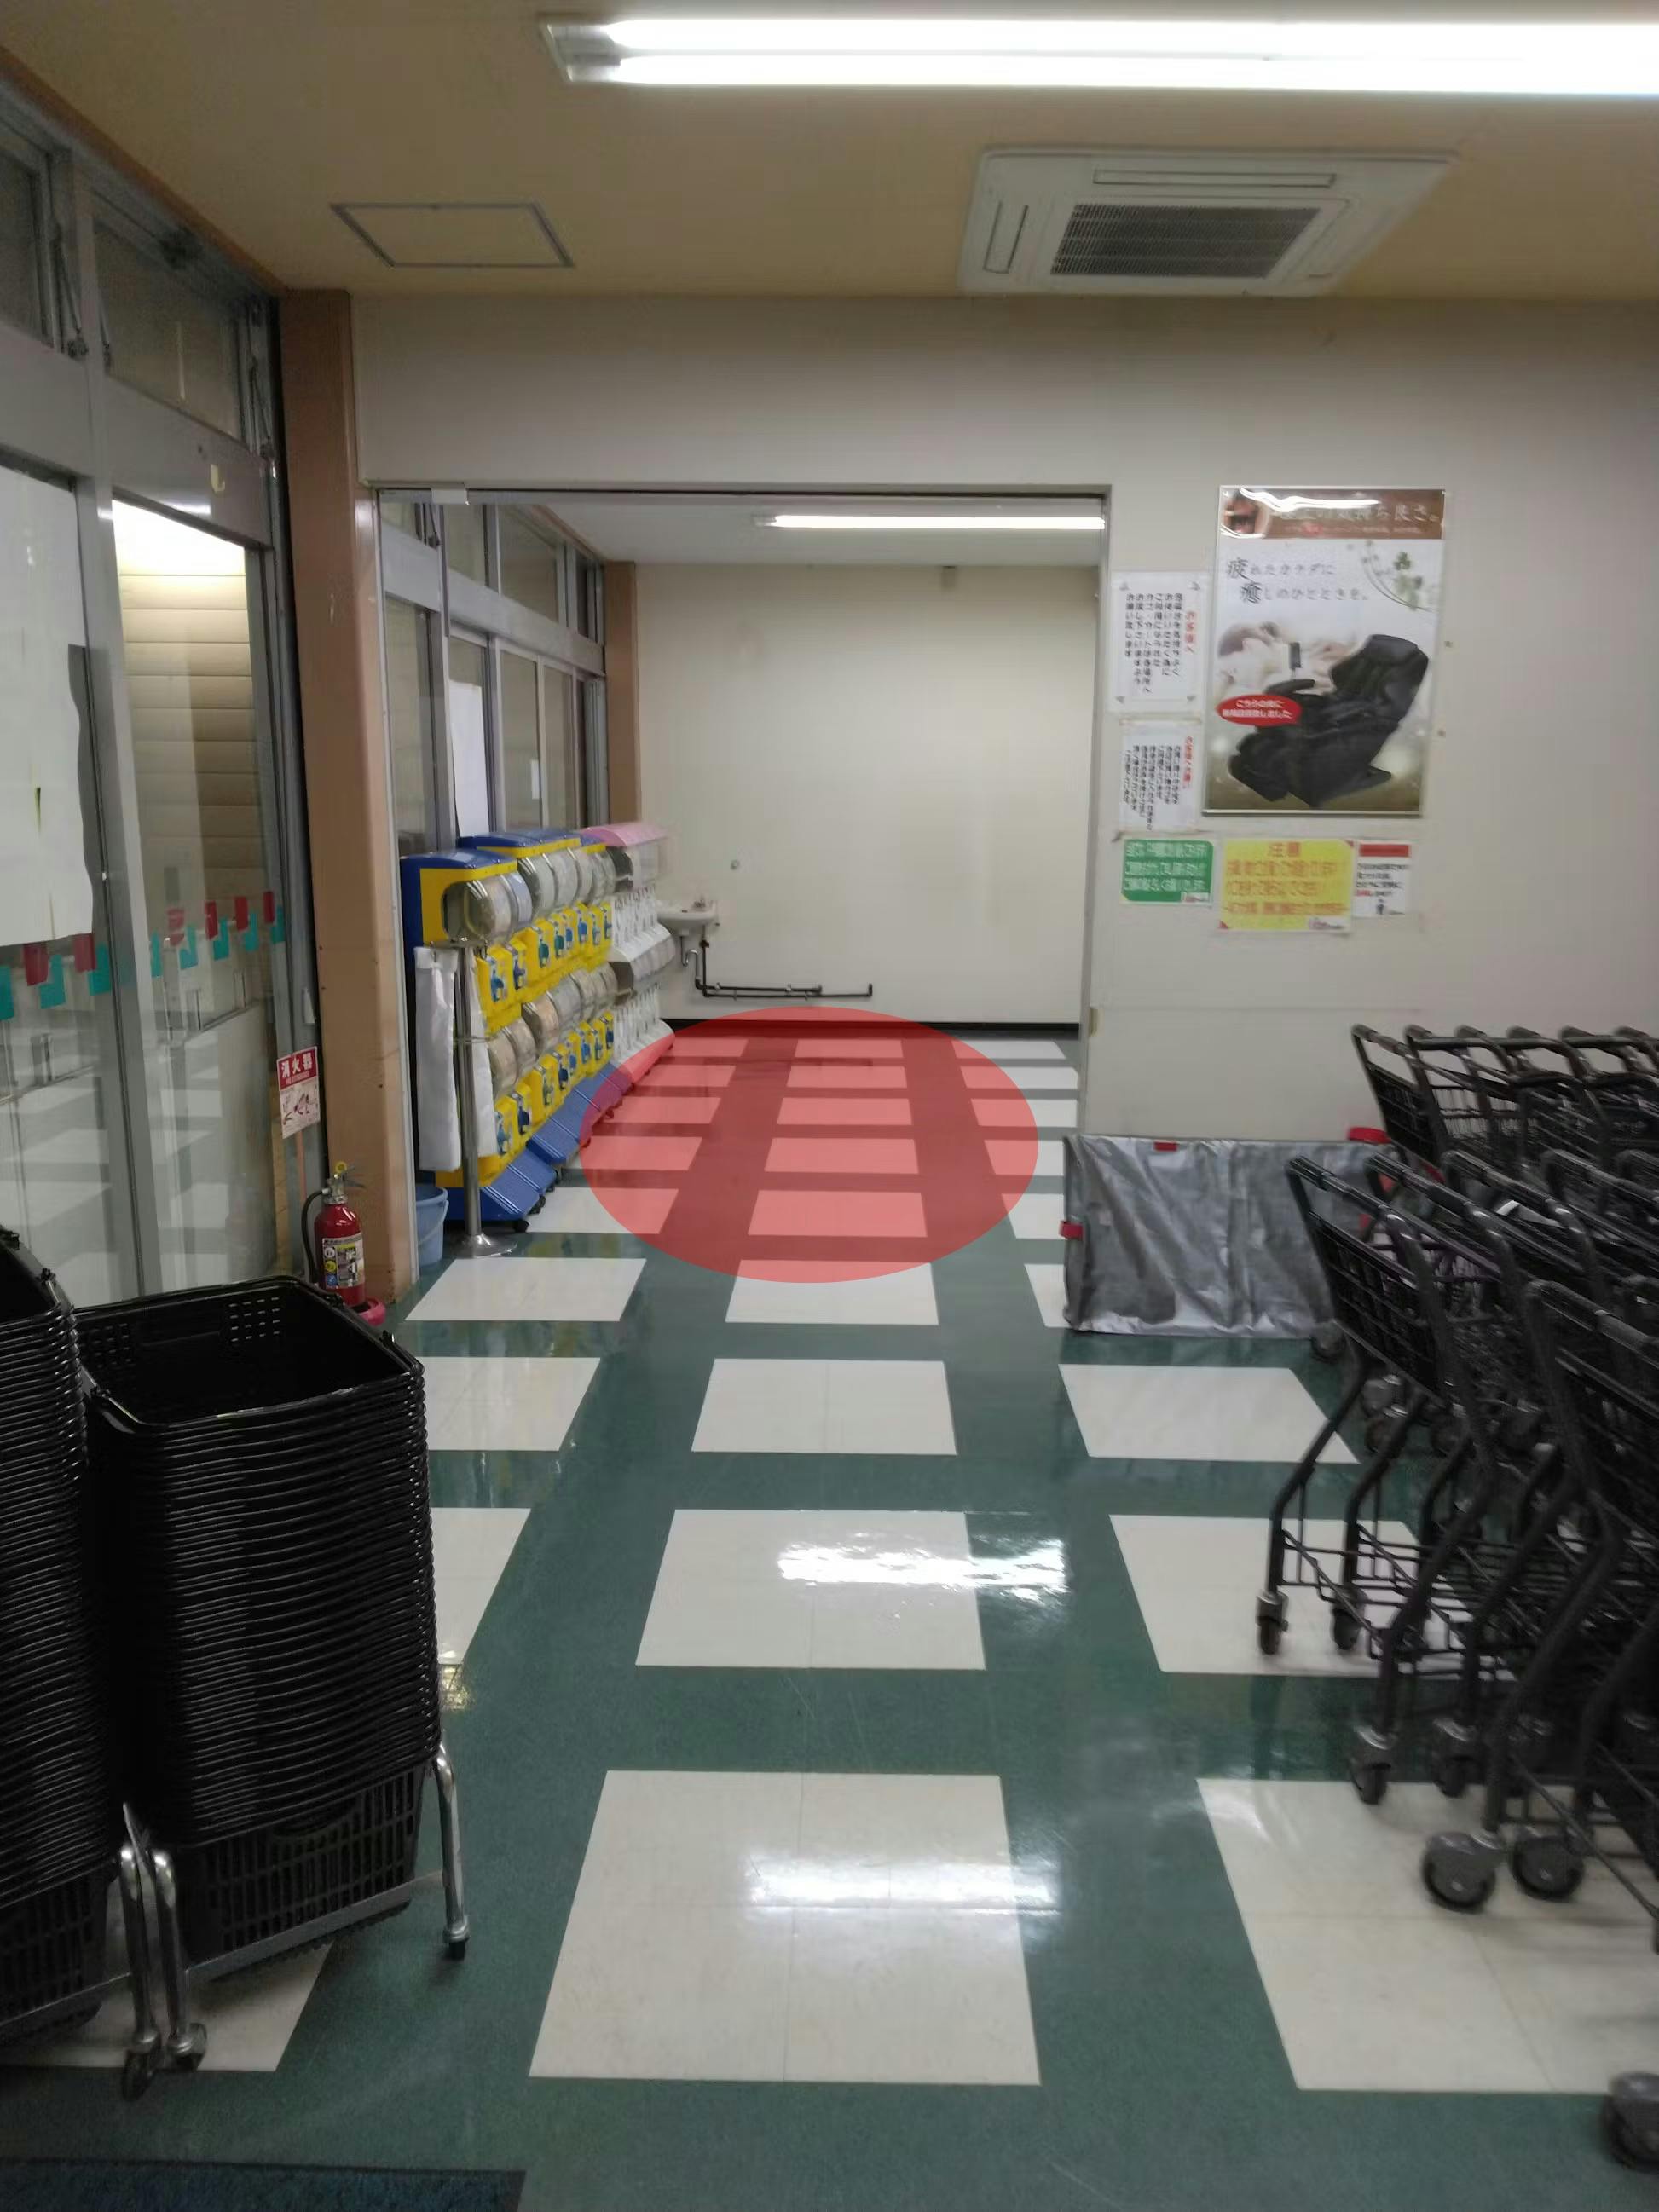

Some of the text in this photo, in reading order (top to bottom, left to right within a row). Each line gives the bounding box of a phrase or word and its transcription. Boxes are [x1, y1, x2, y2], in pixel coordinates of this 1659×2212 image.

[1227, 557, 1335, 583] 疲れたカラダに
[280, 1052, 313, 1079] 消火器
